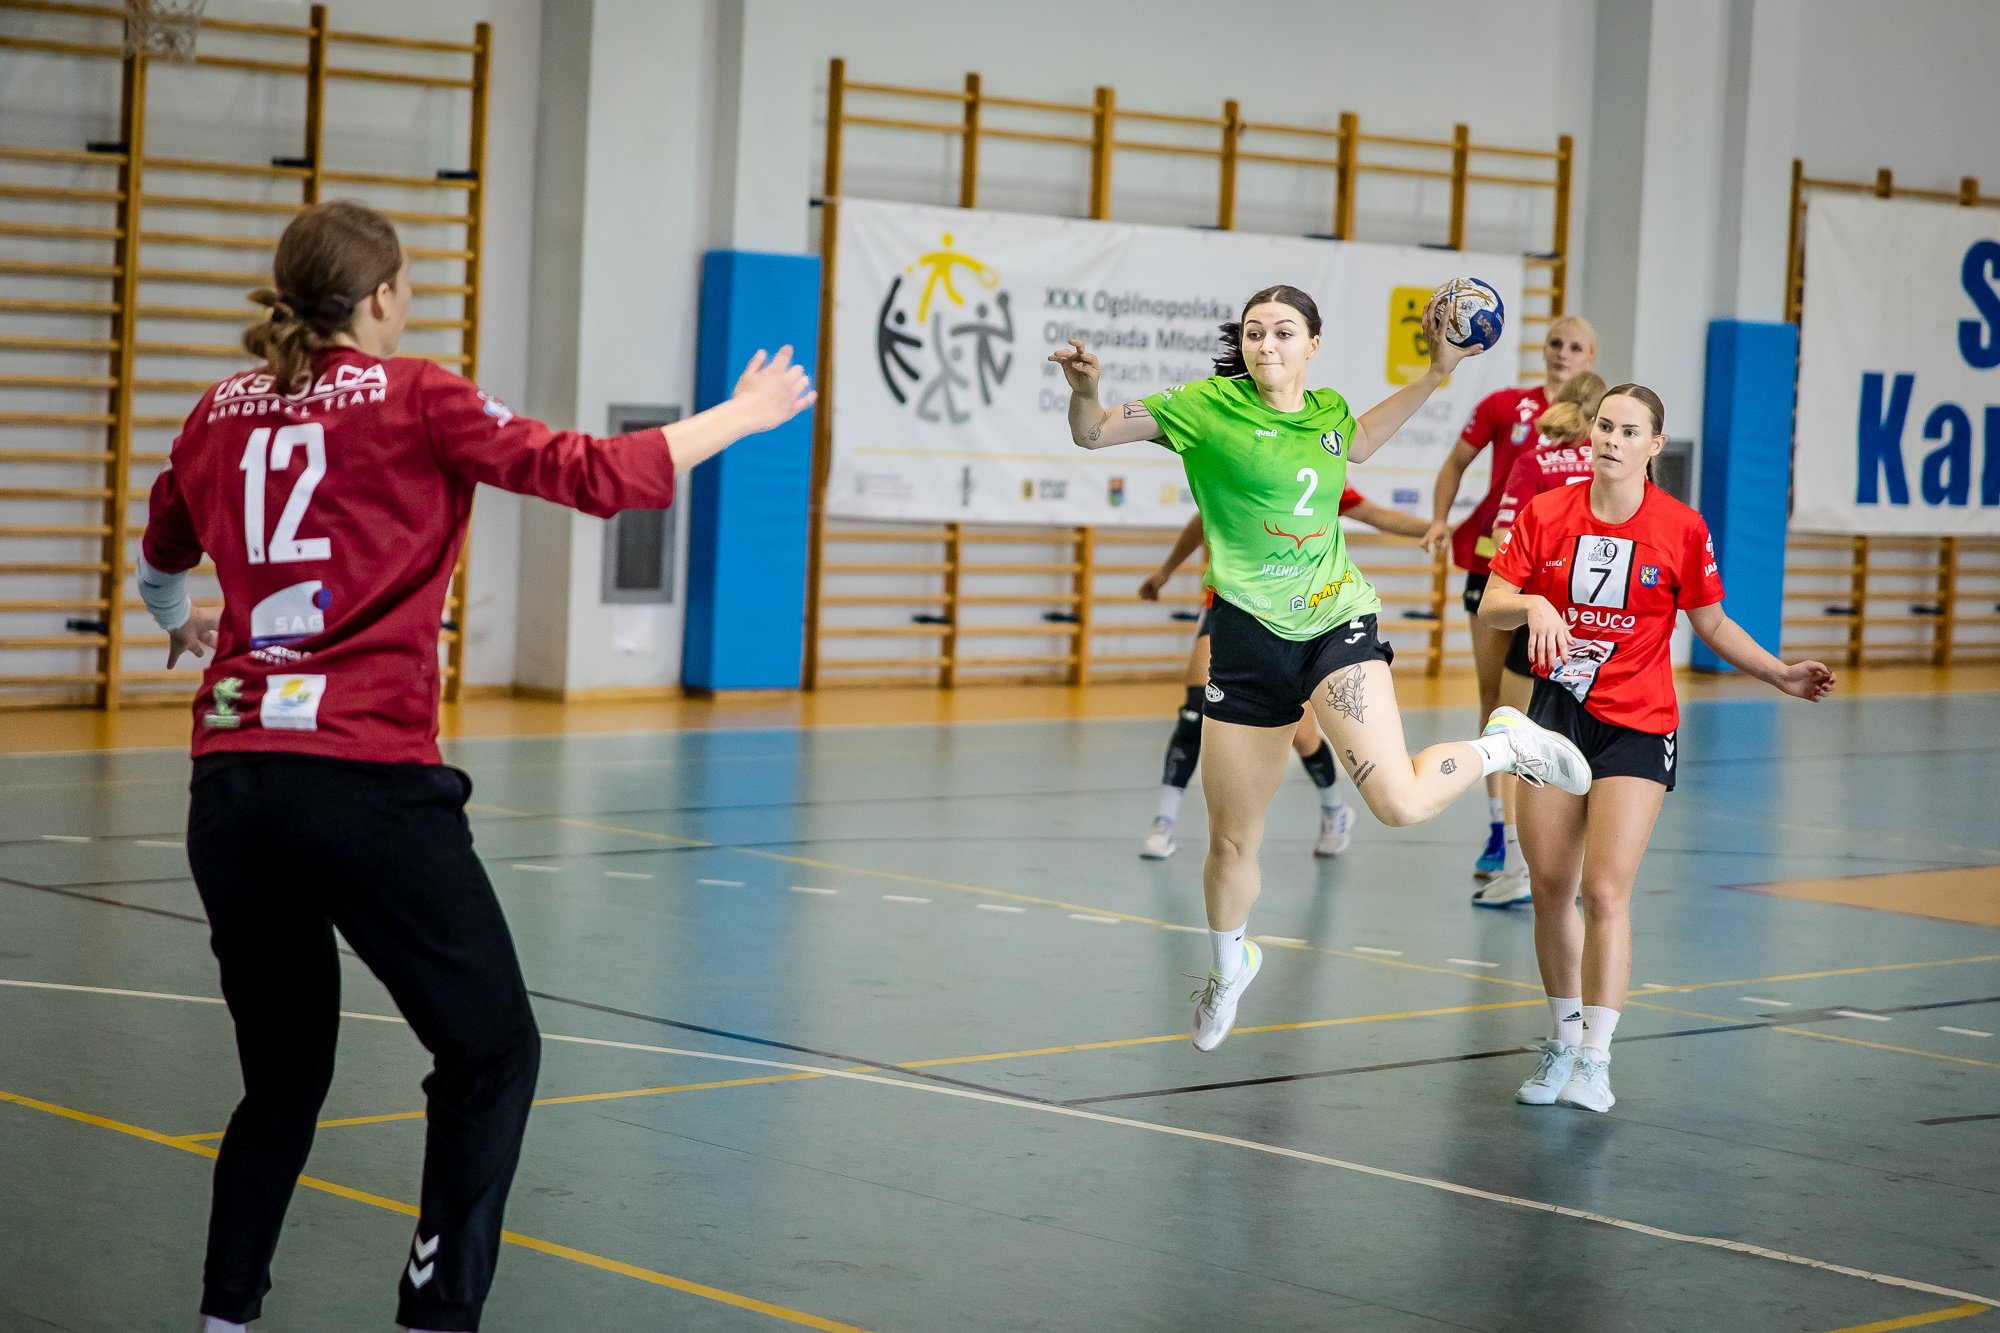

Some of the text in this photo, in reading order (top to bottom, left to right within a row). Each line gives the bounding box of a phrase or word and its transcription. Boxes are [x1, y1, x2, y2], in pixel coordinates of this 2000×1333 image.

[1044, 288, 1233, 321] XXX Ogólnopolska
[1043, 320, 1149, 349] Olimpiada
[213, 373, 277, 401] UKS
[323, 388, 386, 412] TEAM
[239, 422, 331, 564] 12
[1292, 467, 1319, 516] 2
[1260, 563, 1300, 577] JELENIA
[1589, 567, 1612, 604] 7
[1580, 610, 1636, 629] euco
